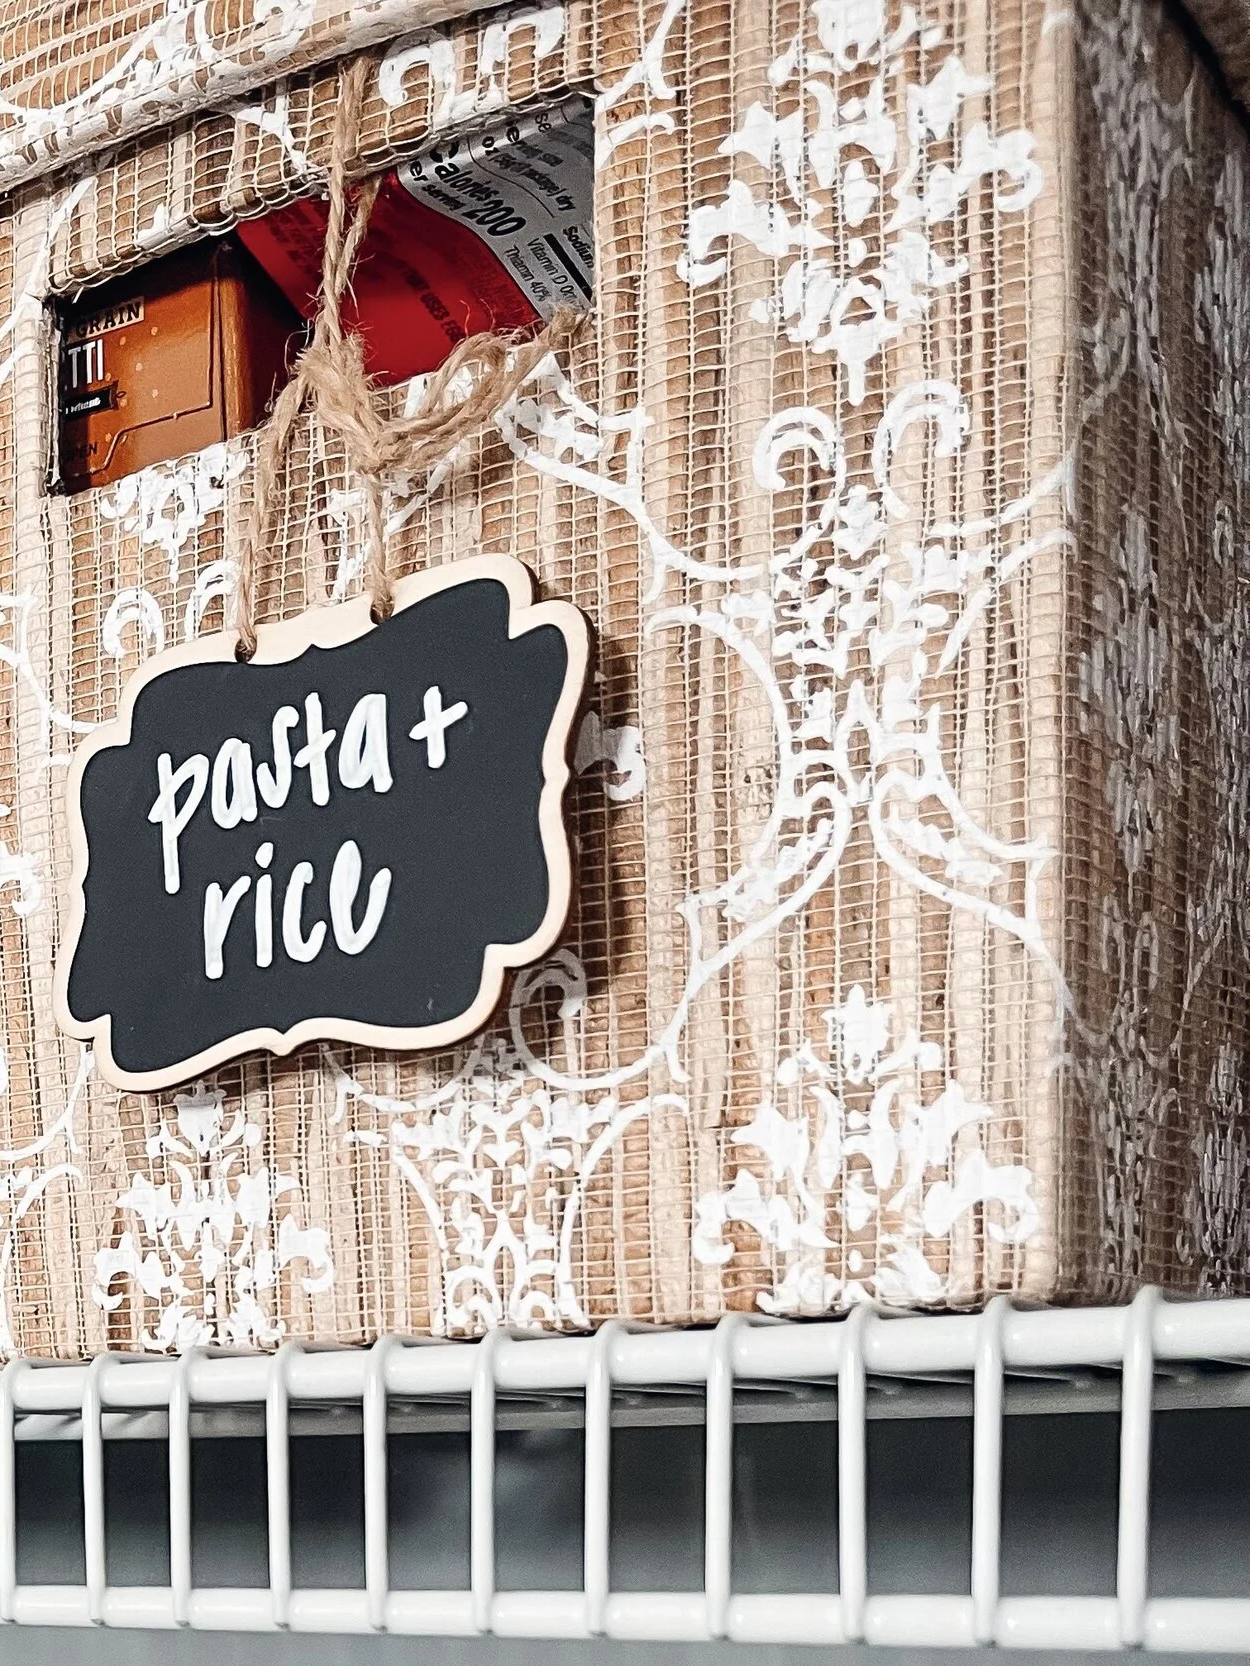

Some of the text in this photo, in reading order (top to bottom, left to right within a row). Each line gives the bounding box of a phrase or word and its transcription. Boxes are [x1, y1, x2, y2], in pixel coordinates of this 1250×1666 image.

[408, 157, 429, 182] er
[428, 140, 500, 202] Calories
[462, 198, 526, 237] 200
[504, 245, 535, 284] Thiamin
[526, 237, 559, 281] Vitamin
[562, 225, 595, 269] Sodium
[75, 301, 142, 338] GRAIN
[148, 685, 469, 895] pasta +
[203, 840, 392, 980] rice
